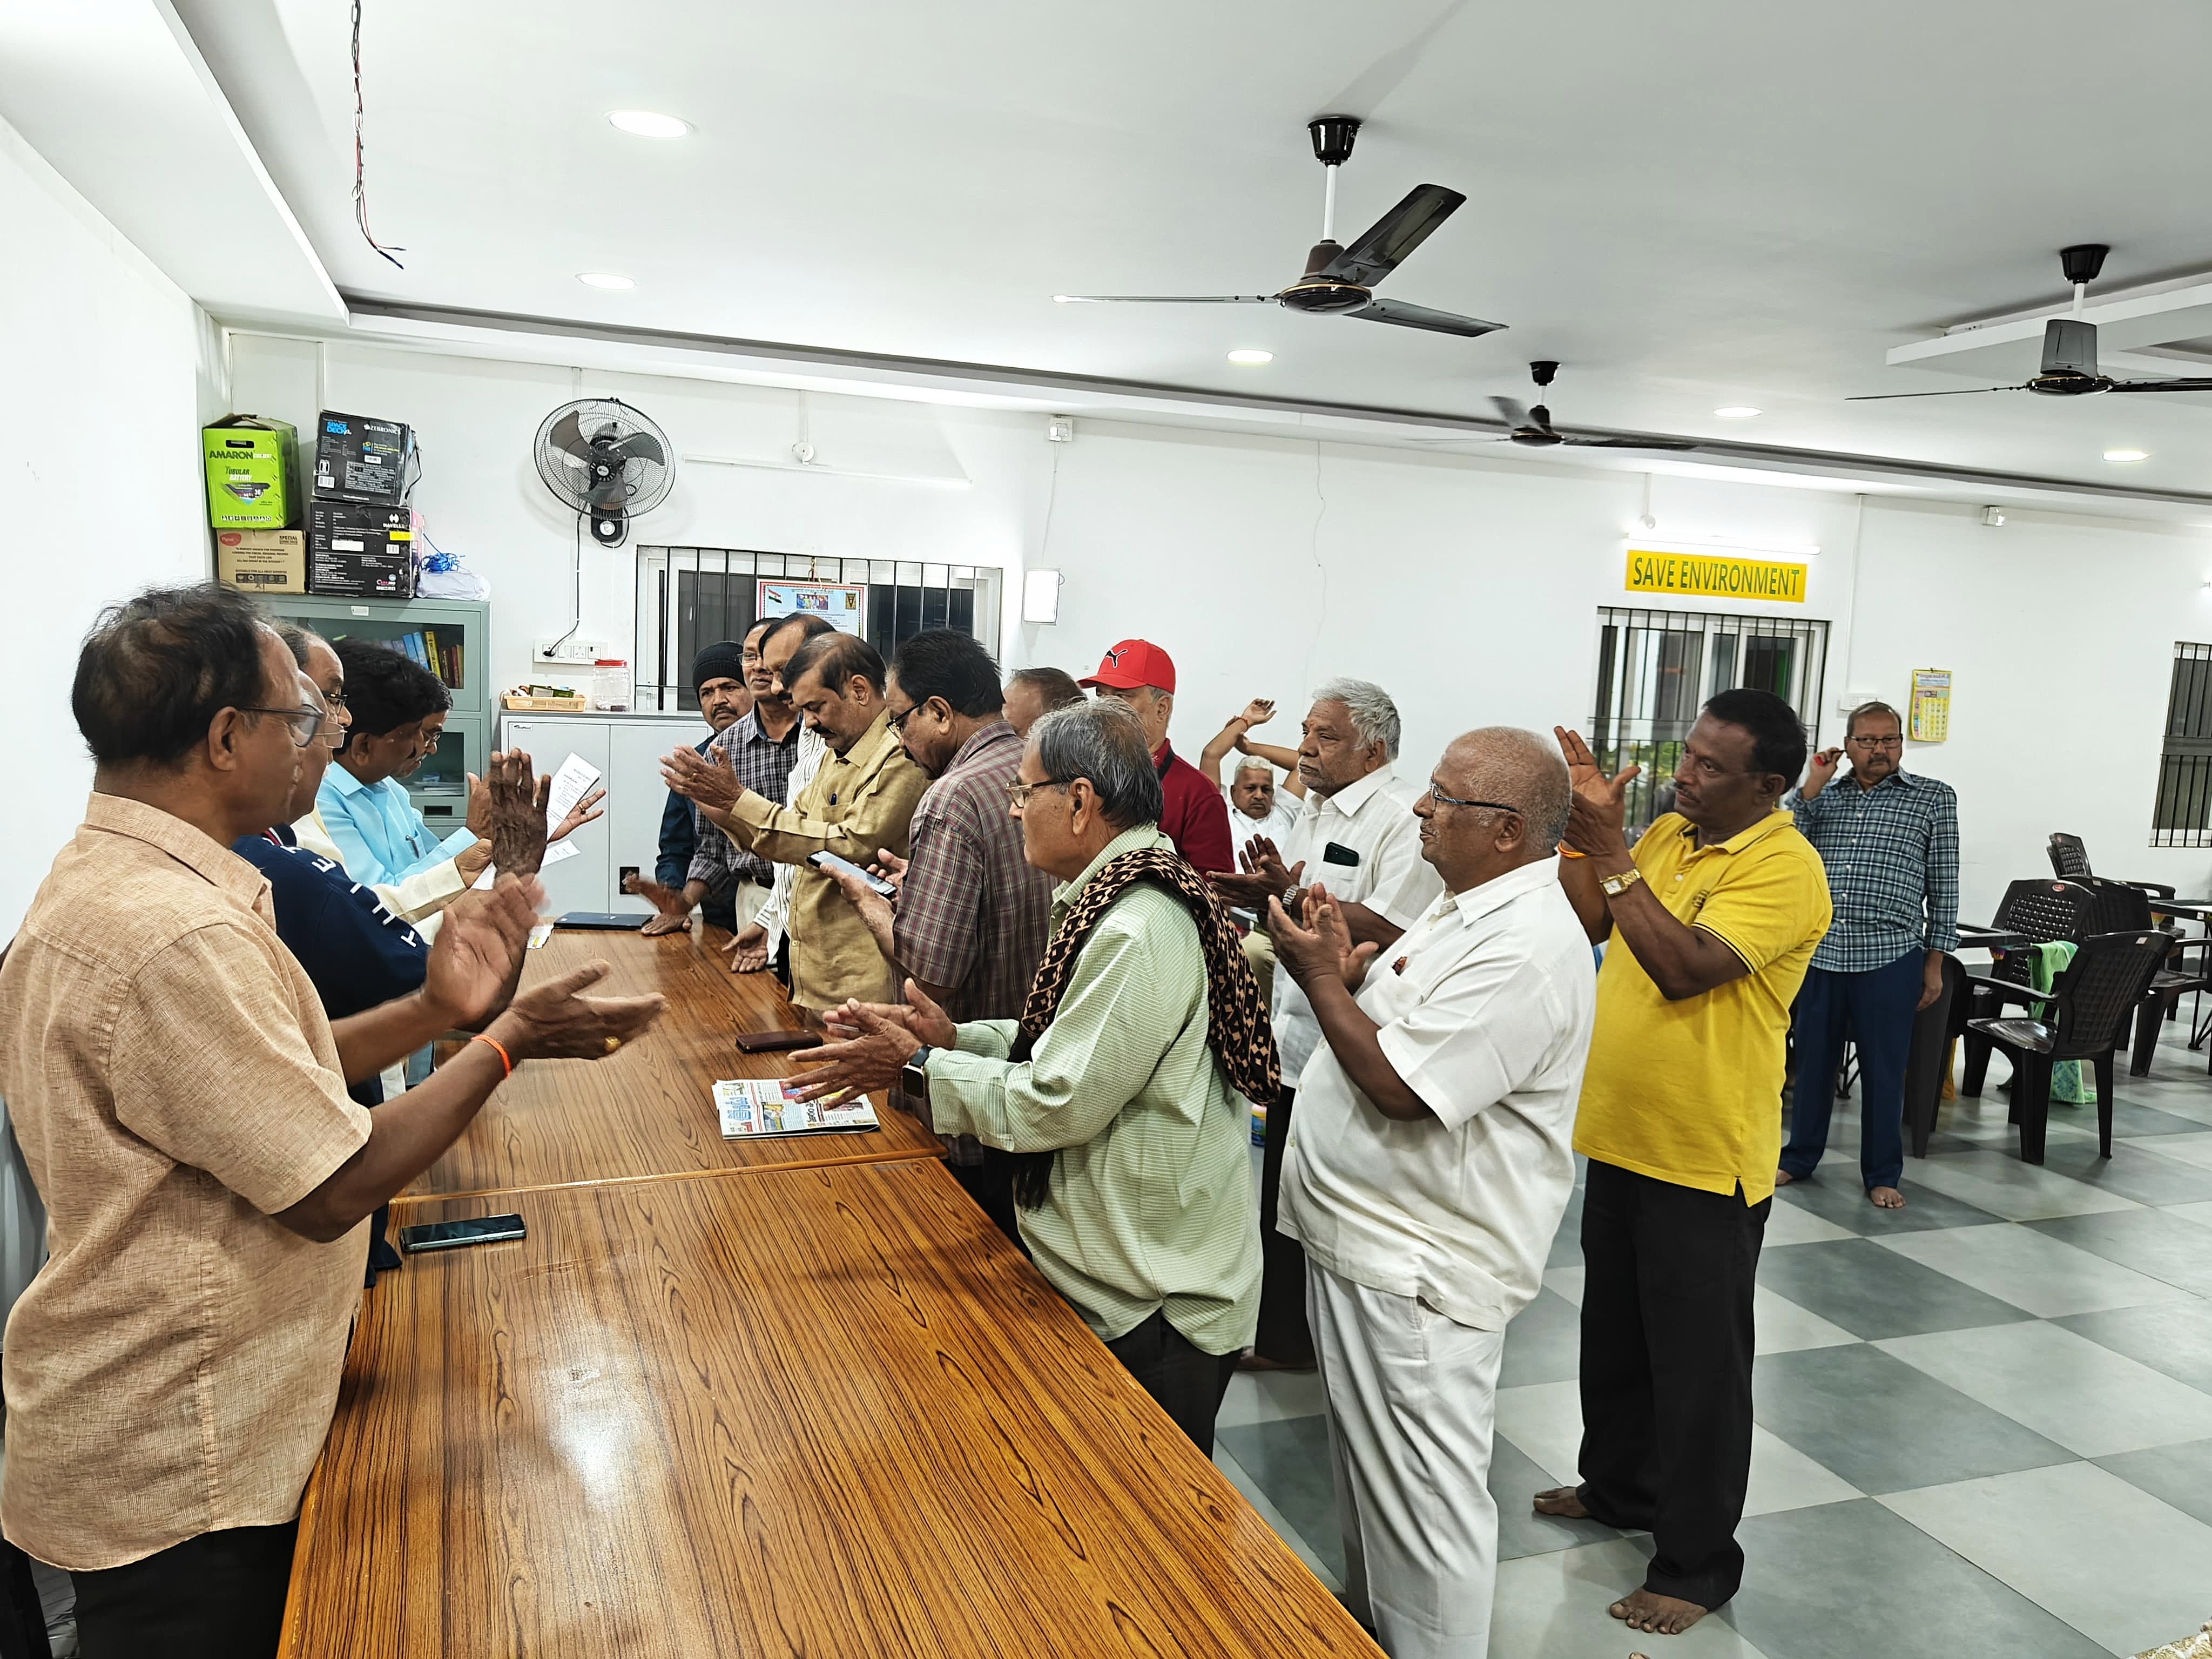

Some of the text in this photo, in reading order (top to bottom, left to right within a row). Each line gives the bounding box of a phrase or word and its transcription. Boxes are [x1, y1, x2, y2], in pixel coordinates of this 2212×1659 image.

[209, 450, 253, 459] AMARON
[1633, 557, 1800, 596] SAVE ENVIRONMENT
